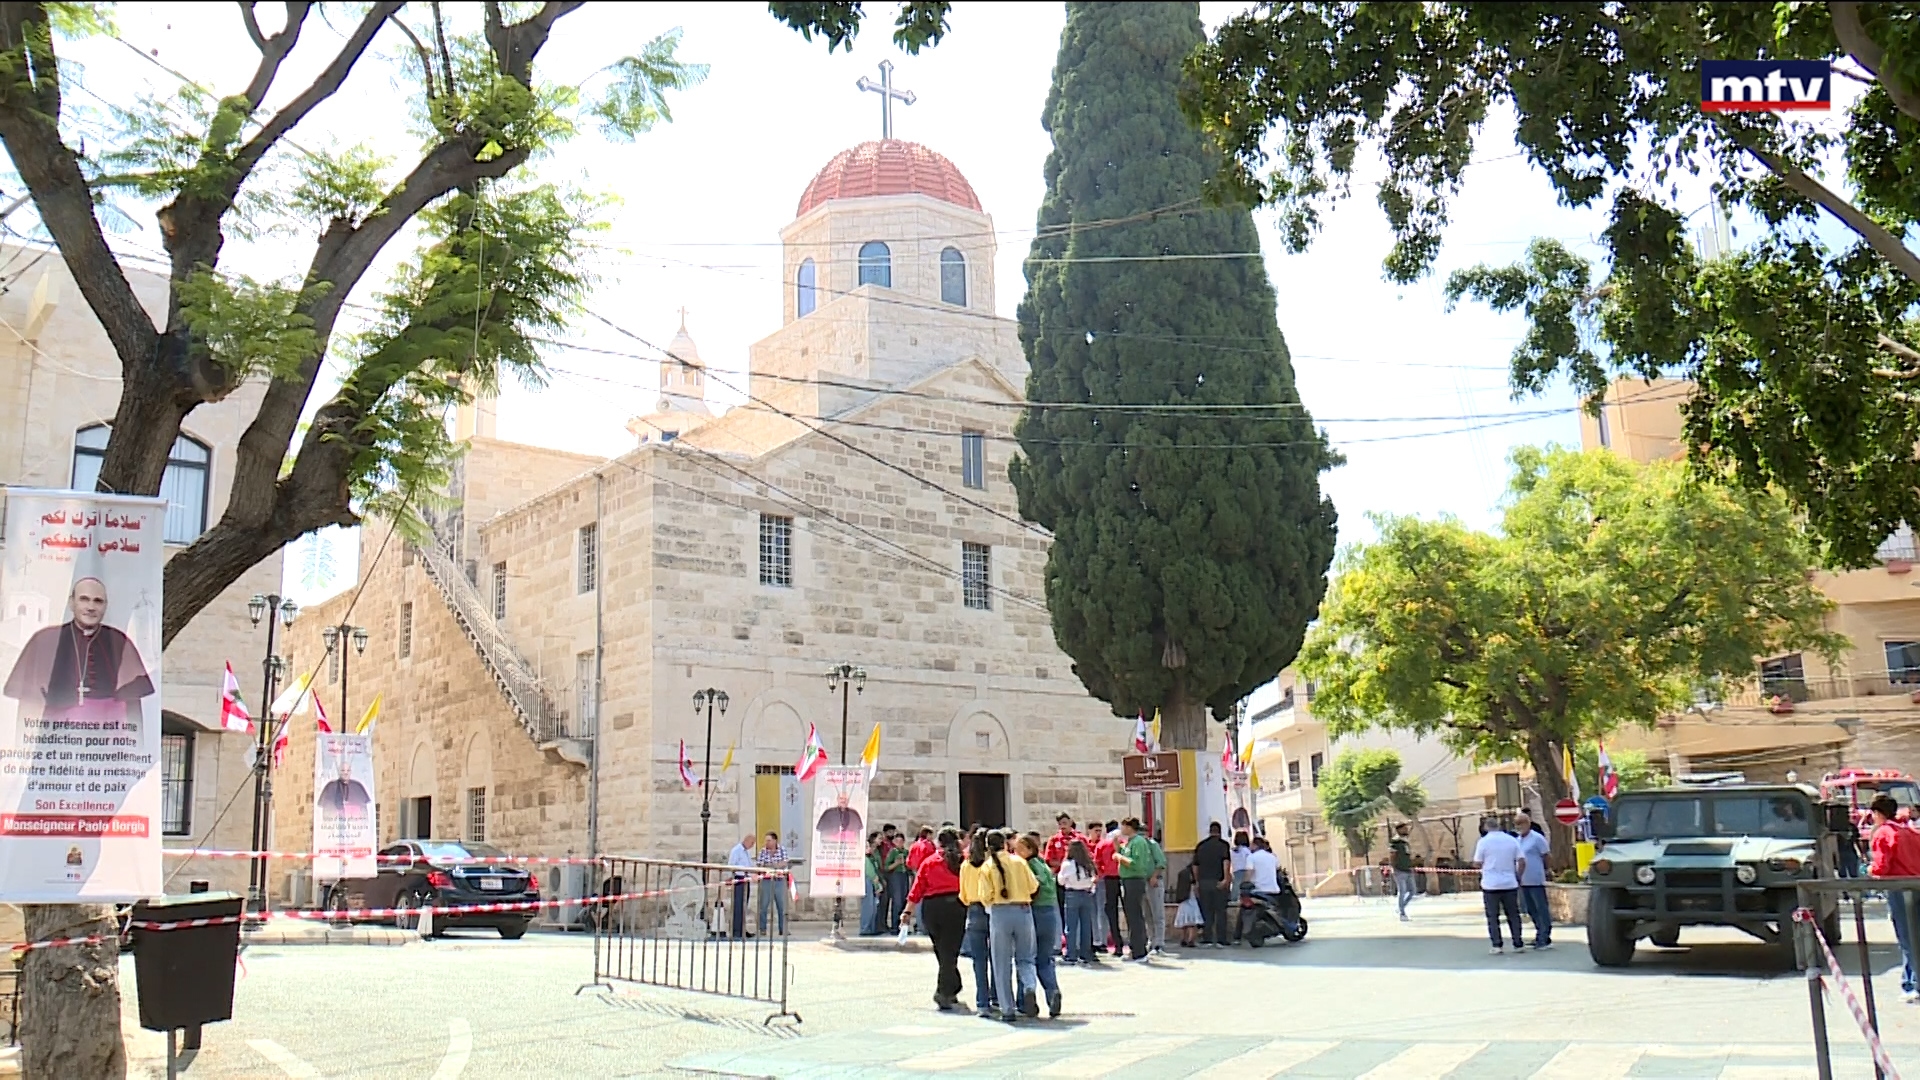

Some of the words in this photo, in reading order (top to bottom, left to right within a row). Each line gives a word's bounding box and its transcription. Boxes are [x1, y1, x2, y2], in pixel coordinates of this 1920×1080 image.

[24, 717, 50, 730] Votre
[53, 718, 100, 732] présence
[103, 720, 119, 730] est
[122, 721, 138, 732] une
[23, 733, 83, 746] bénédiction
[85, 736, 111, 748] pour
[113, 736, 137, 748] notre
[0, 748, 43, 760] paroisse
[46, 750, 57, 760] et
[60, 751, 73, 760] un
[75, 751, 152, 764] renouvellement
[3, 764, 17, 774] de
[19, 765, 46, 776] notre
[49, 765, 85, 776] fidélité
[87, 767, 101, 776] au
[104, 767, 147, 780] message
[28, 780, 73, 792] d'amour
[75, 782, 86, 792] et
[88, 781, 101, 792] de
[104, 782, 127, 794] paix
[35, 799, 56, 810] Son
[59, 799, 115, 812] Excellence
[3, 818, 76, 834] Monseigneur
[78, 818, 109, 832] Paolo
[112, 820, 146, 834] Borgia
